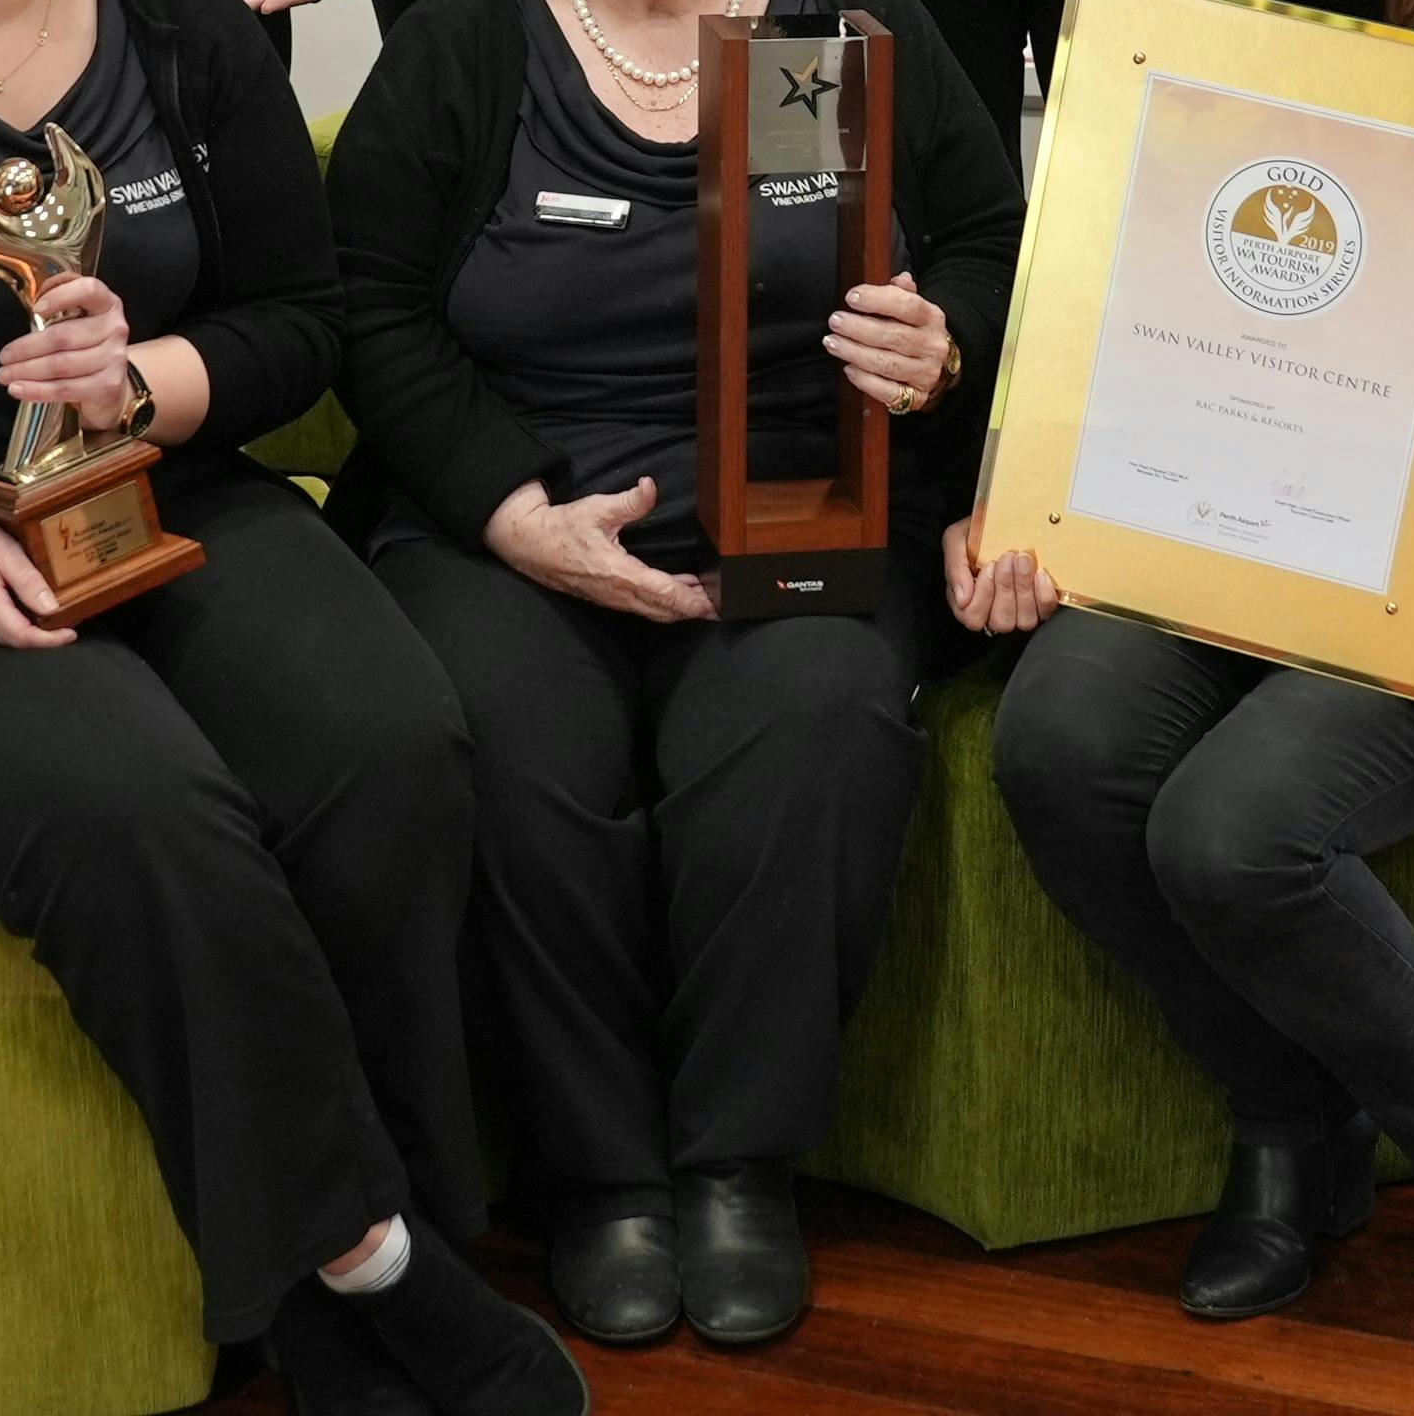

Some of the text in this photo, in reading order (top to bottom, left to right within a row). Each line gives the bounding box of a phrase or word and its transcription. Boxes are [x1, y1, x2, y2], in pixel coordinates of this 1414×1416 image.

[109, 178, 158, 204] SWAN
[153, 167, 181, 192] VAL
[759, 178, 811, 197] SWAN
[1267, 166, 1324, 192] GOLD
[771, 191, 824, 207] VINEYARDS
[1243, 238, 1321, 263] PERTH AIRPORT
[1299, 234, 1335, 253] 2019
[1212, 209, 1356, 309] VISITOR INFORMATION SERVICES
[1236, 245, 1321, 276] WA TOURISM
[1251, 263, 1306, 285] AWARDS
[1132, 323, 1393, 399] SWAN VALLEY VISITOR CENTRE
[1195, 400, 1304, 433] RAC PARKS & RESORTS
